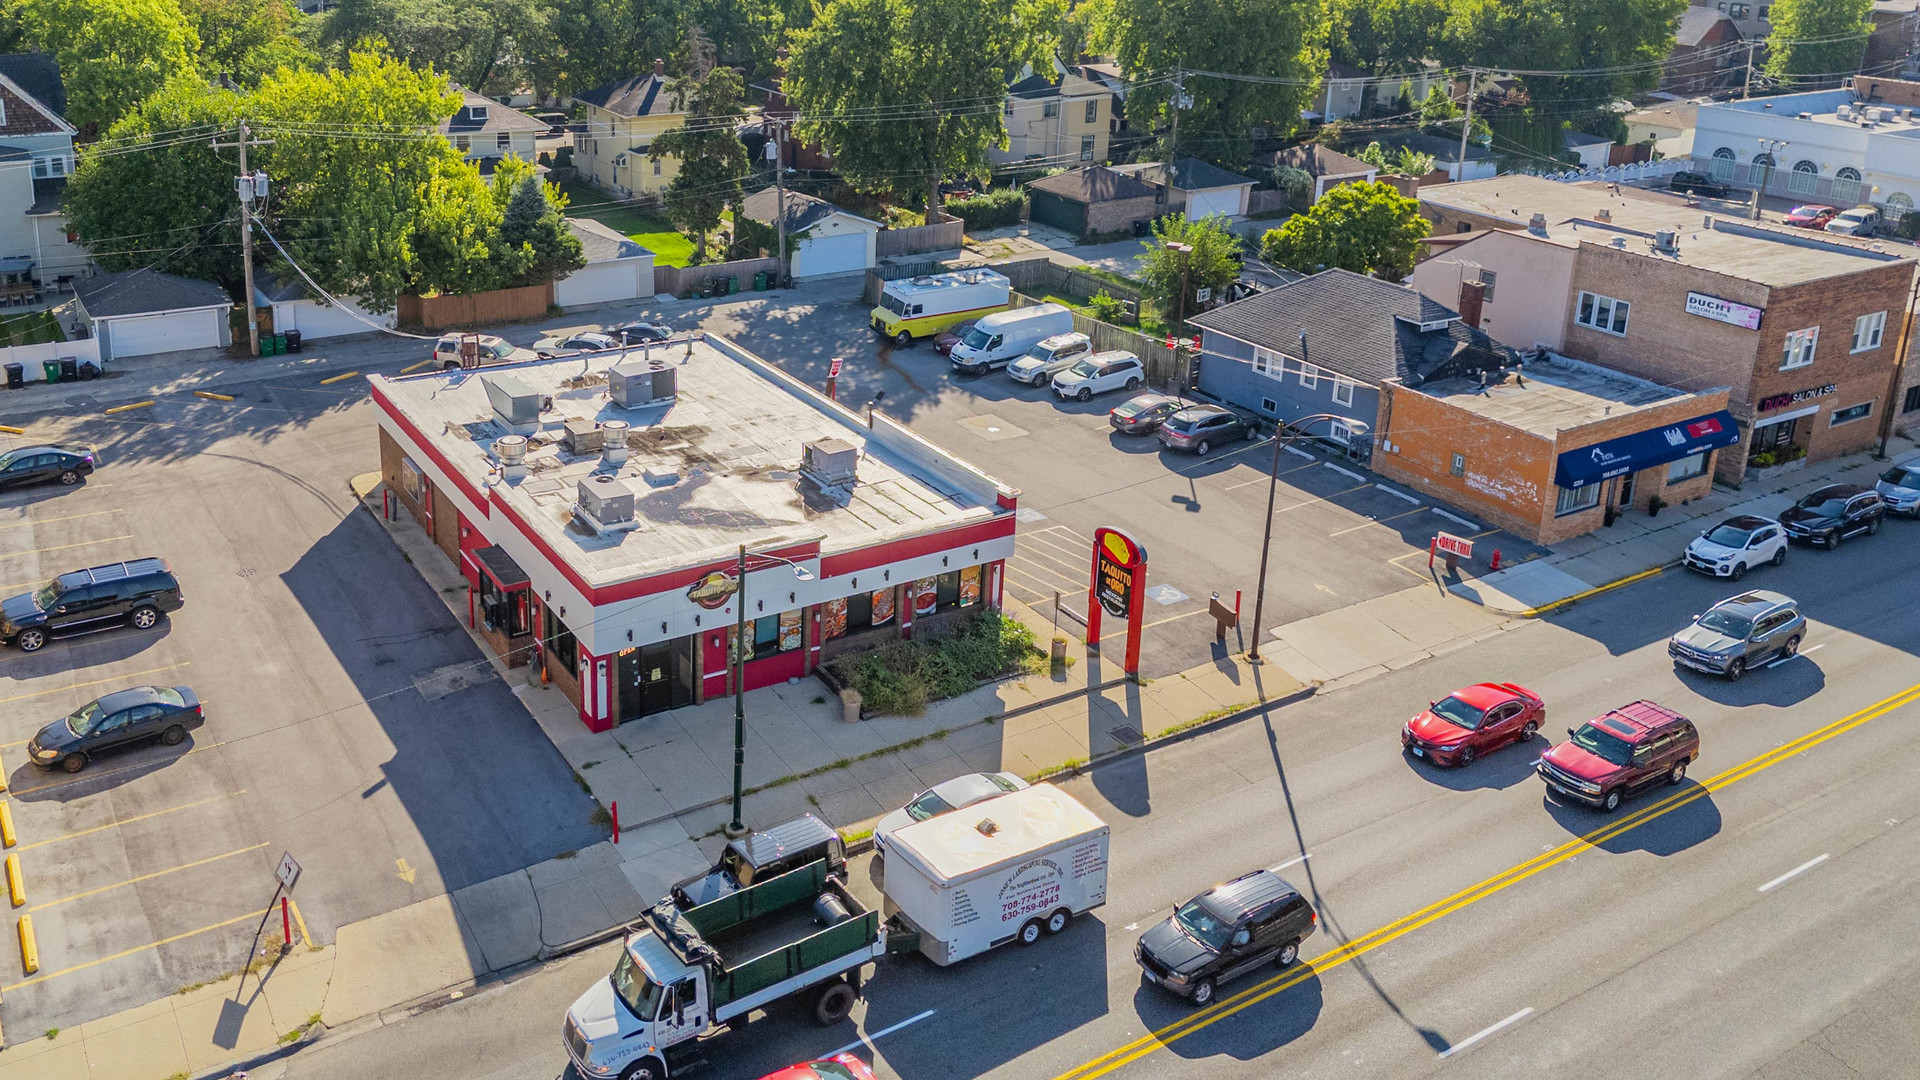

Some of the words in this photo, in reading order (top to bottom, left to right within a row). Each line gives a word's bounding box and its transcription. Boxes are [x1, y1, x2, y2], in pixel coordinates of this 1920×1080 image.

[1688, 304, 1711, 314] SALON
[1792, 389, 1817, 404] SALON
[1817, 387, 1823, 397] &
[1823, 384, 1837, 395] SPA
[1441, 536, 1457, 552] DRIVE
[1457, 541, 1471, 557] THRU
[1101, 559, 1132, 587] TAQUITO
[693, 586, 721, 599] TAQUITO
[1111, 580, 1125, 596] ORO
[619, 647, 637, 657] OPEN
[1001, 894, 1060, 922] 630-759-0843
[1002, 884, 1060, 912] 708-774-2778
